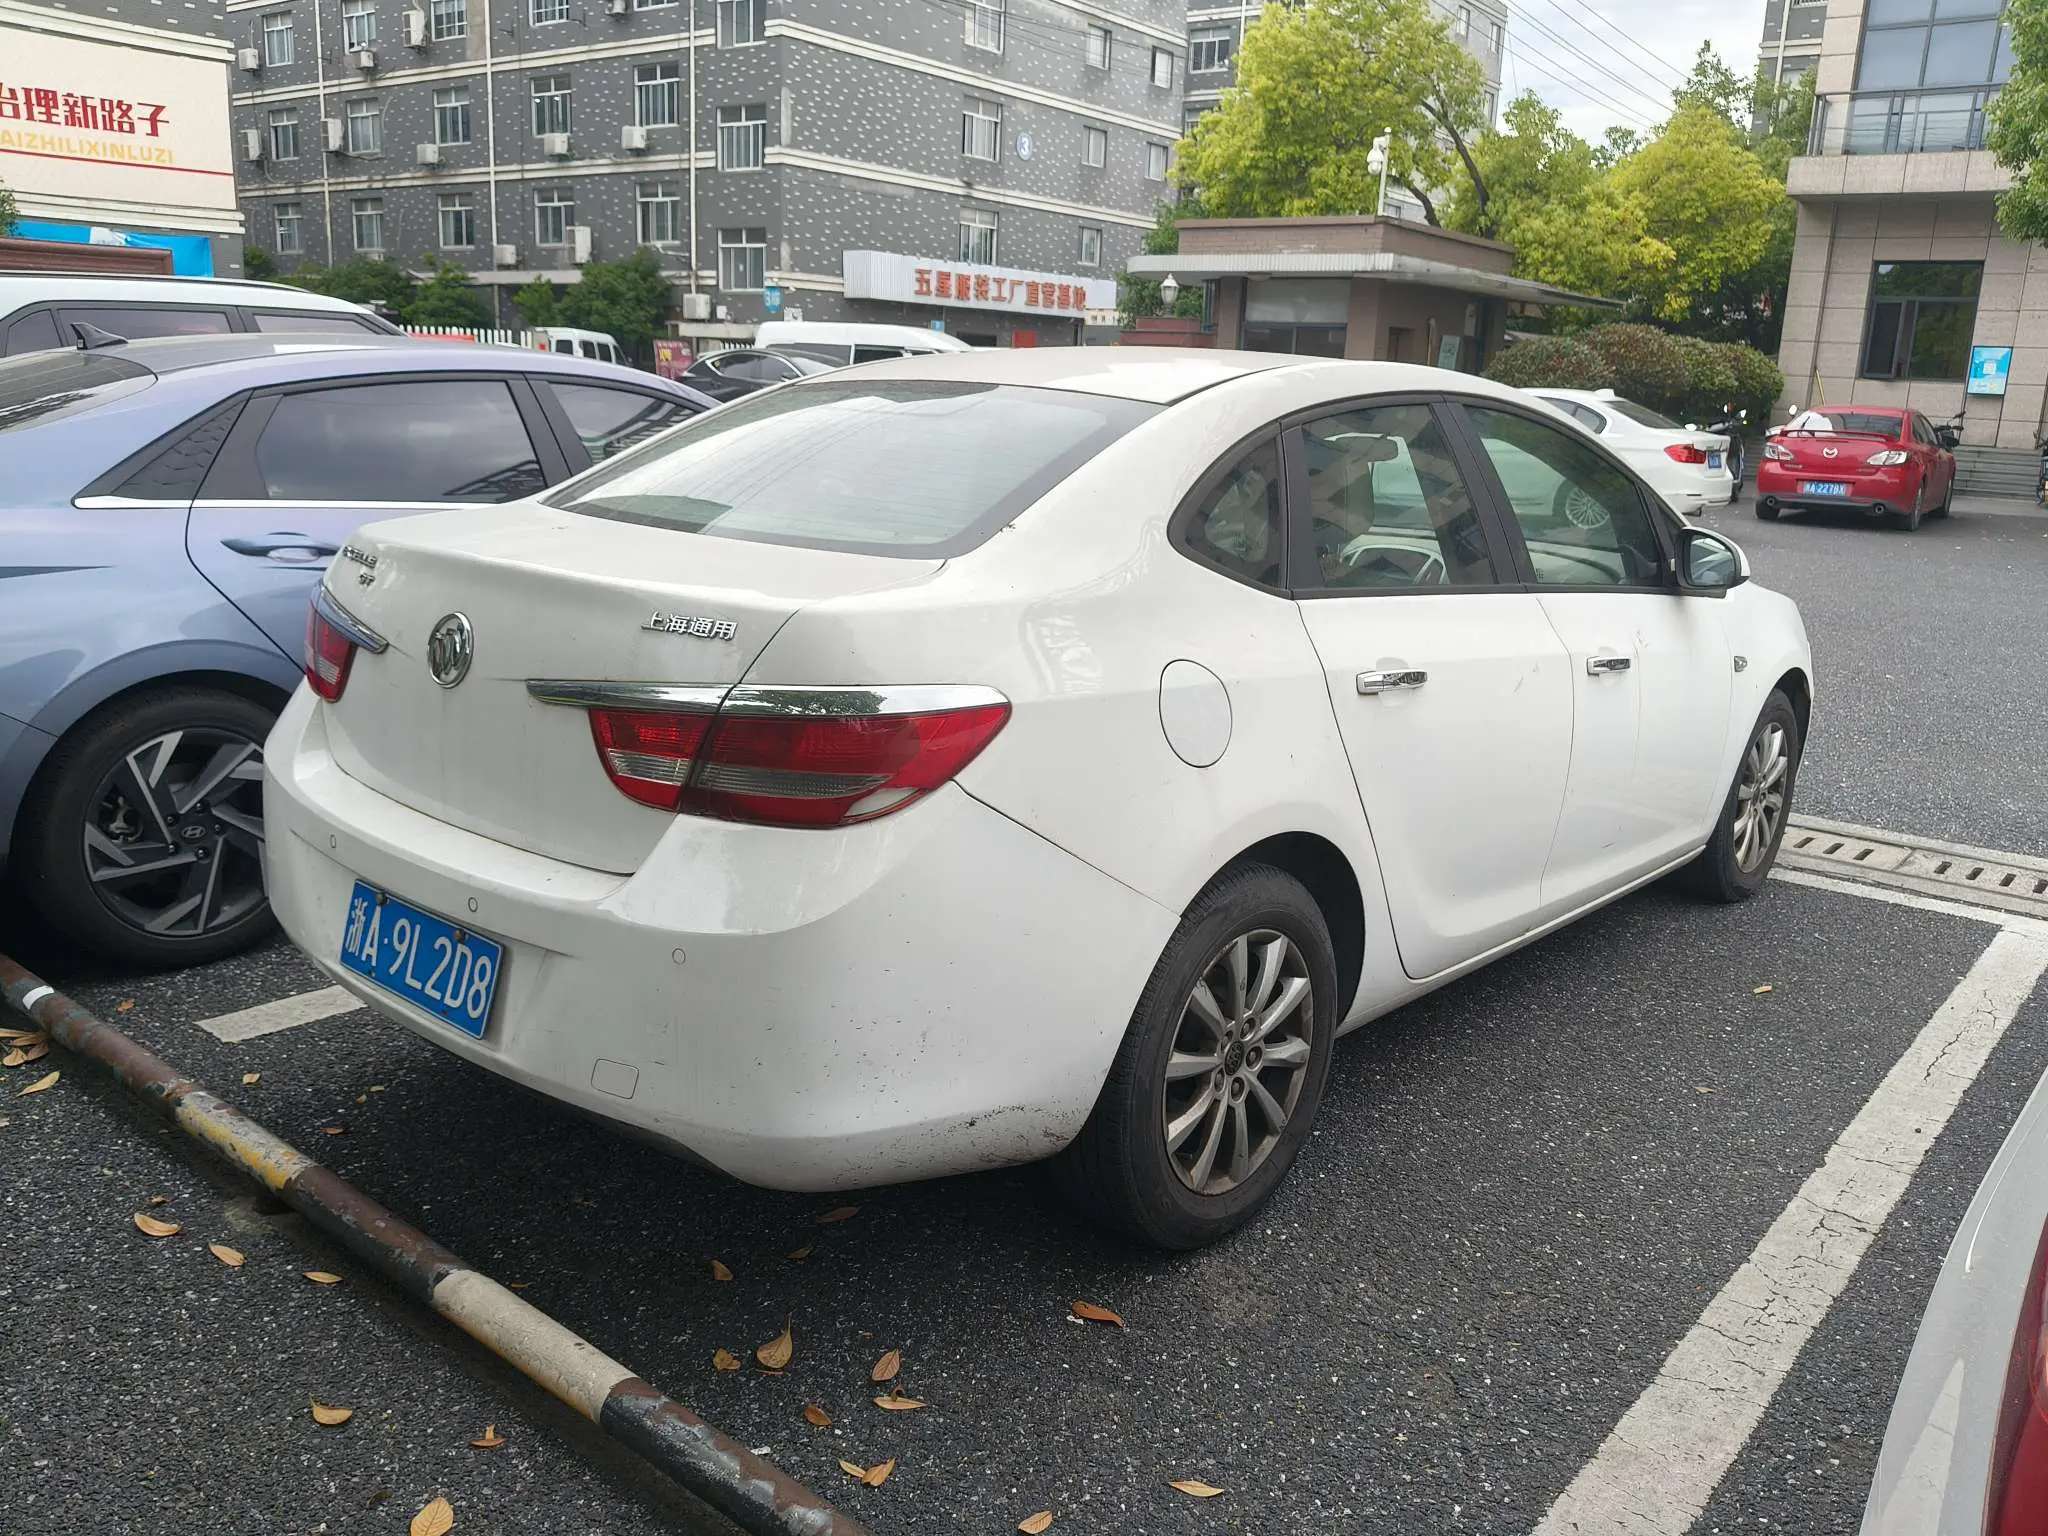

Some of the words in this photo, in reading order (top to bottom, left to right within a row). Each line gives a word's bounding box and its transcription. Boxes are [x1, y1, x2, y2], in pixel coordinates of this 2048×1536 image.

[1020, 137, 1030, 154] 3
[914, 268, 1086, 311] 五星服装工厂直营基地
[641, 611, 738, 640] 上海通用
